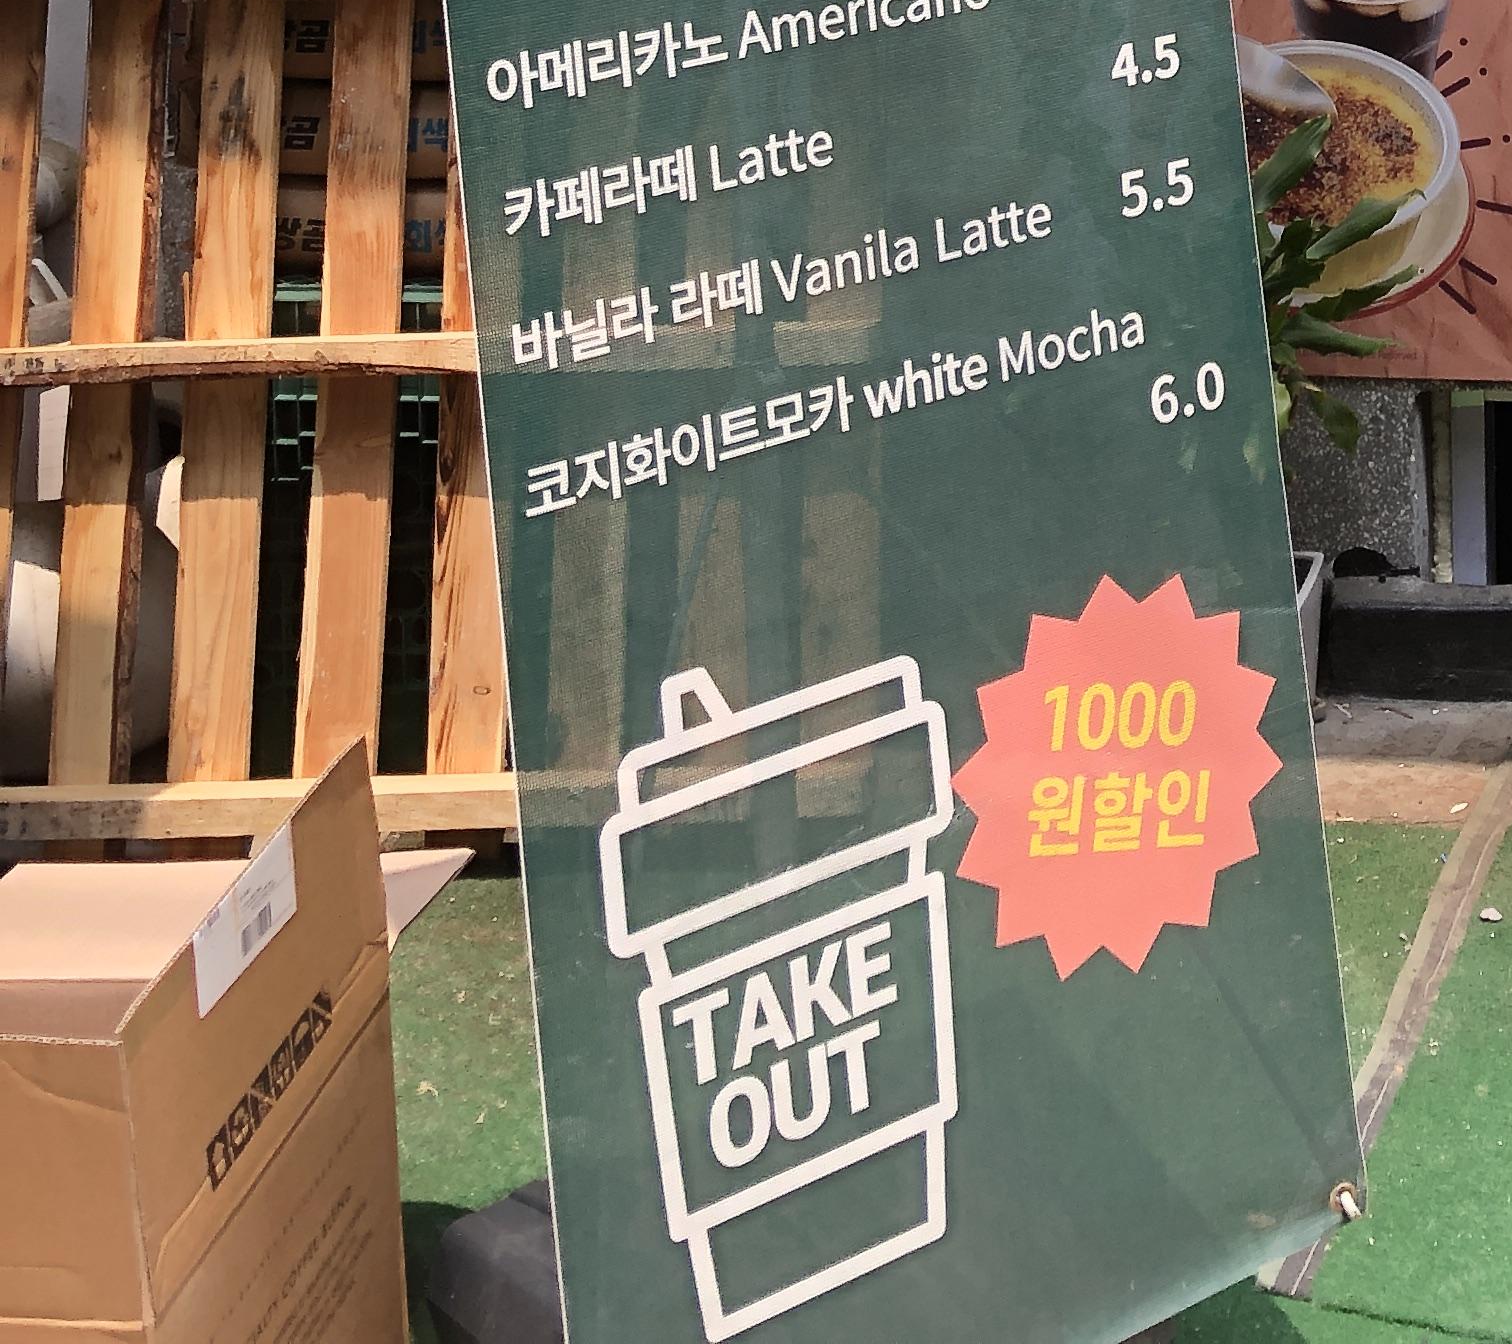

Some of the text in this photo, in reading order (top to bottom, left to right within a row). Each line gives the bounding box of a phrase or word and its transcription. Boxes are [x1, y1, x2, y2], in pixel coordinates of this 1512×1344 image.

[486, 20, 730, 112] 아메리카노
[503, 32, 1182, 239] 카페라떼 Latte 4.5
[510, 157, 1196, 371] 바닐라 라떼 Vanila Latte 5.5
[524, 308, 1228, 520] 코지화이트모카 white Mocha 6.0
[1041, 679, 1196, 753] 1000
[1028, 769, 1211, 860] 원할인
[673, 922, 898, 1086] TAKE
[709, 1020, 882, 1169] OUT
